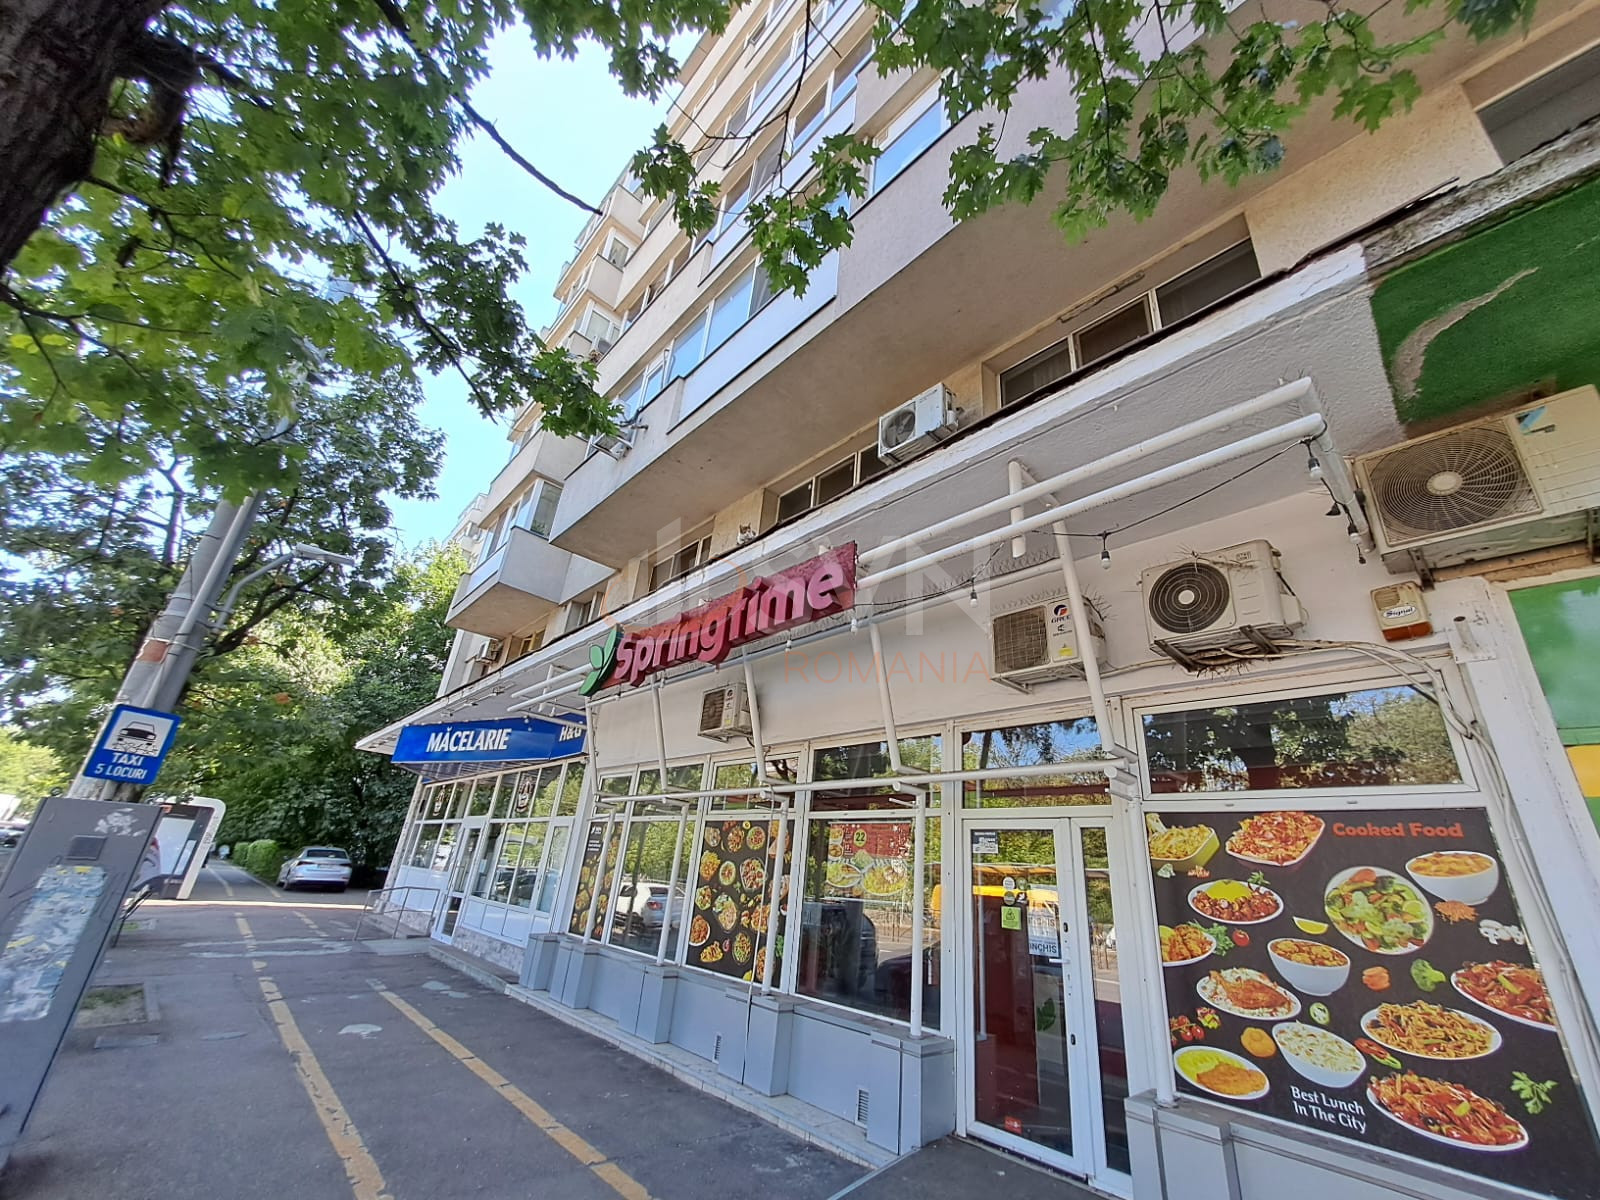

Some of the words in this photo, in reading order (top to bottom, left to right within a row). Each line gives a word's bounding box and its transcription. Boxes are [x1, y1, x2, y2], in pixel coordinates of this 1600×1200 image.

[1385, 606, 1413, 617] Signal
[613, 562, 849, 686] Springtime
[426, 726, 512, 753] MĂCELARIE
[111, 752, 145, 767] TAXI
[94, 763, 106, 775] 5
[105, 765, 148, 780] LOCURI
[1332, 822, 1404, 837] Cooked
[1408, 822, 1464, 838] Food
[1290, 1085, 1319, 1104] Best
[1319, 1093, 1366, 1116] Lunch
[1292, 1100, 1309, 1117] In
[1308, 1104, 1336, 1124] The
[1338, 1113, 1367, 1134] City
